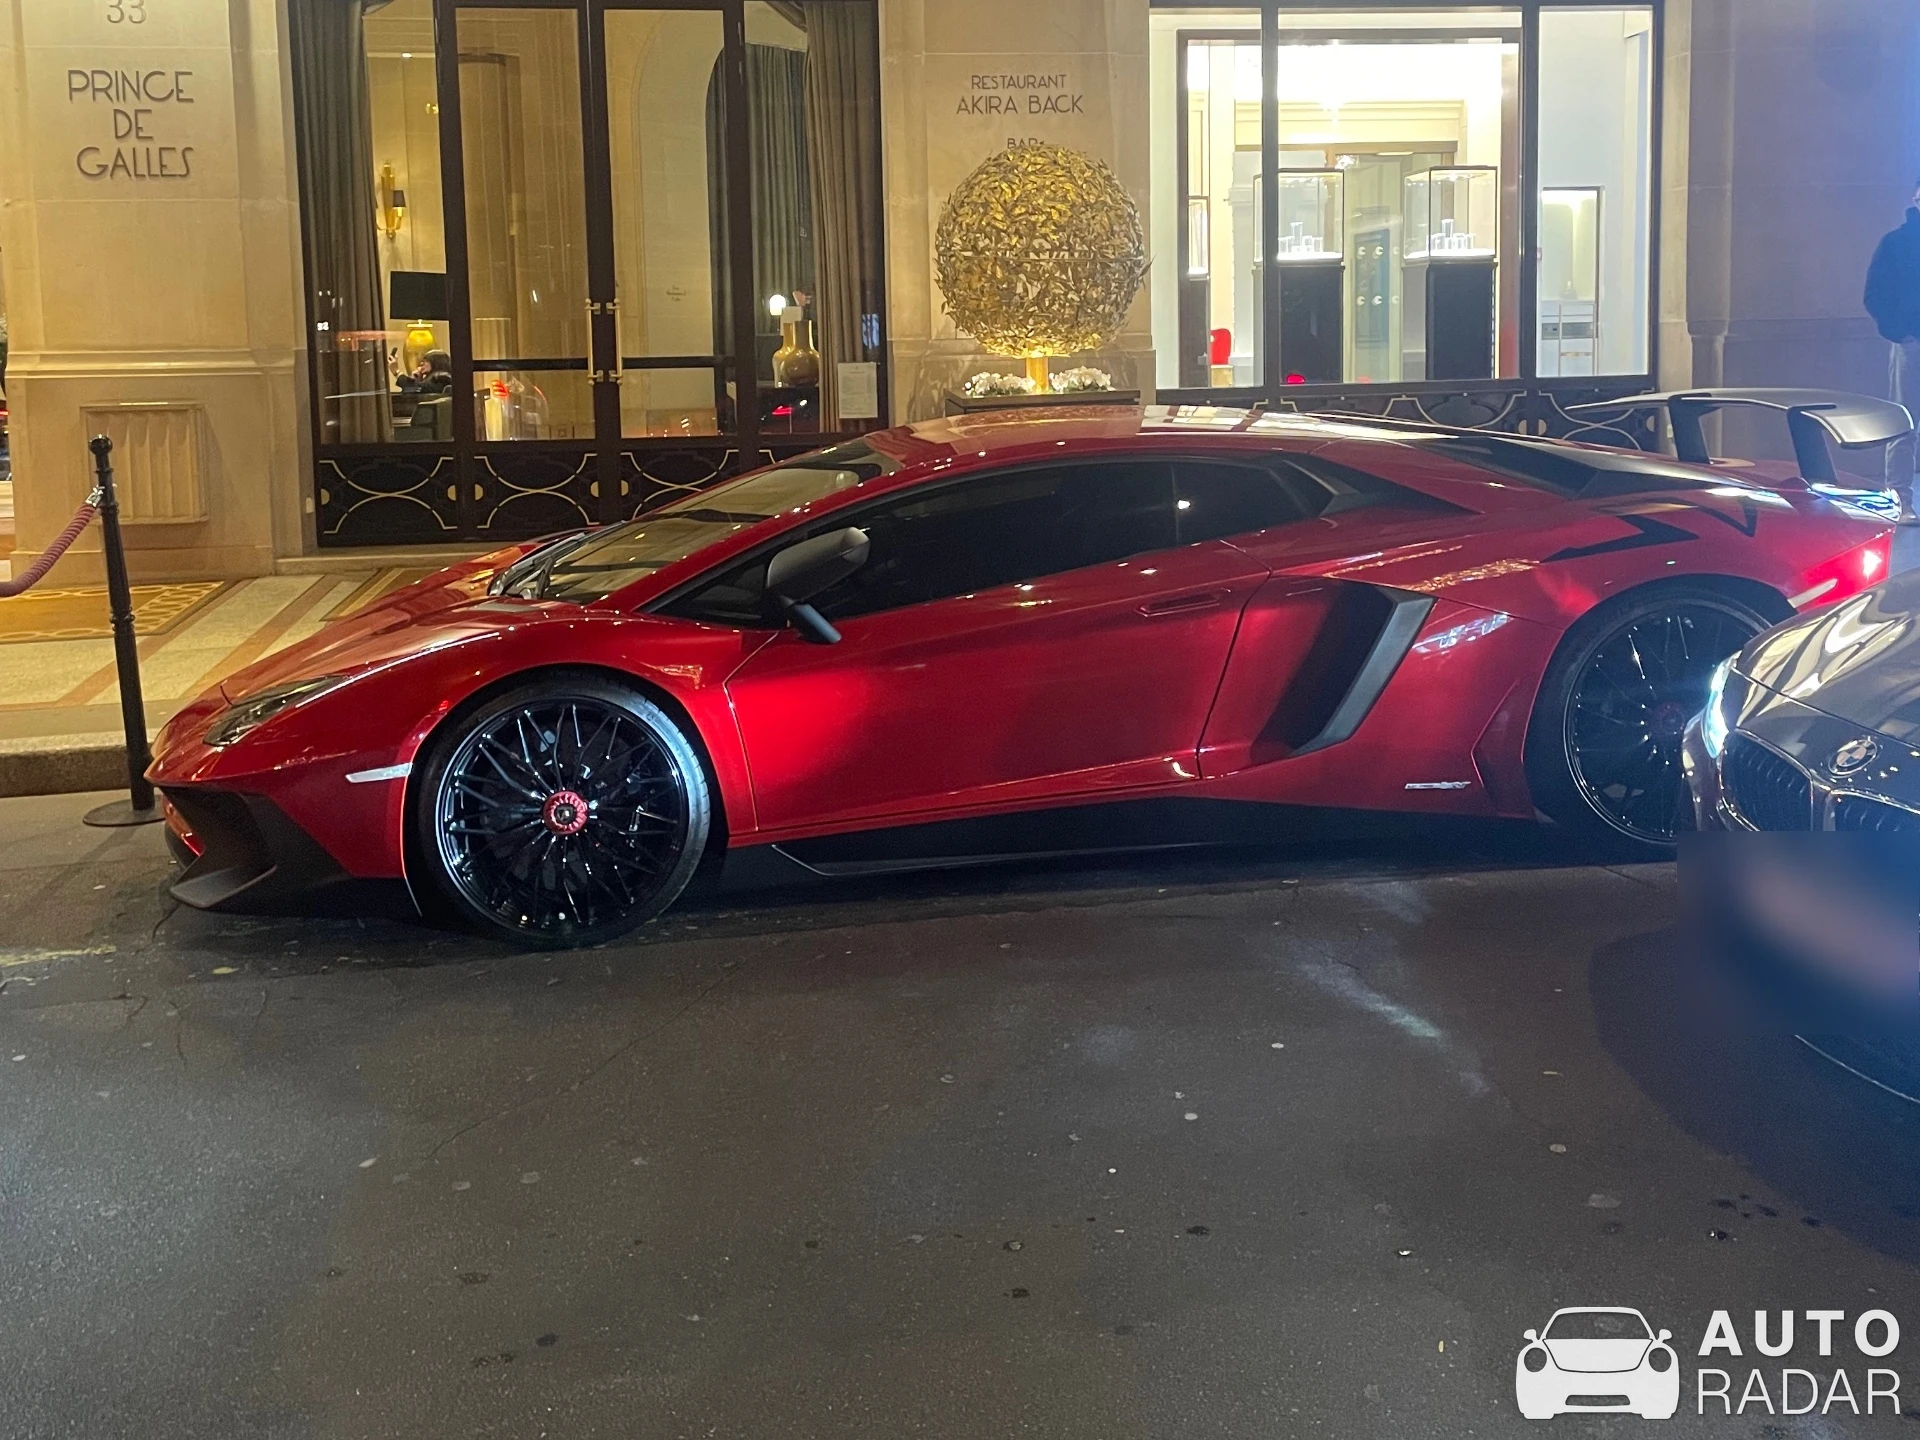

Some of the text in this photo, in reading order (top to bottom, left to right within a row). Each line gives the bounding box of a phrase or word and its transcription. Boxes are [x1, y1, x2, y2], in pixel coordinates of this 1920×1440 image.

[106, 0, 146, 24] 33
[67, 69, 194, 103] PRINCE
[971, 74, 1067, 90] RESTAURANT
[956, 94, 1084, 115] AKIRA BACK
[113, 108, 153, 140] DE
[76, 146, 194, 178] GALLES
